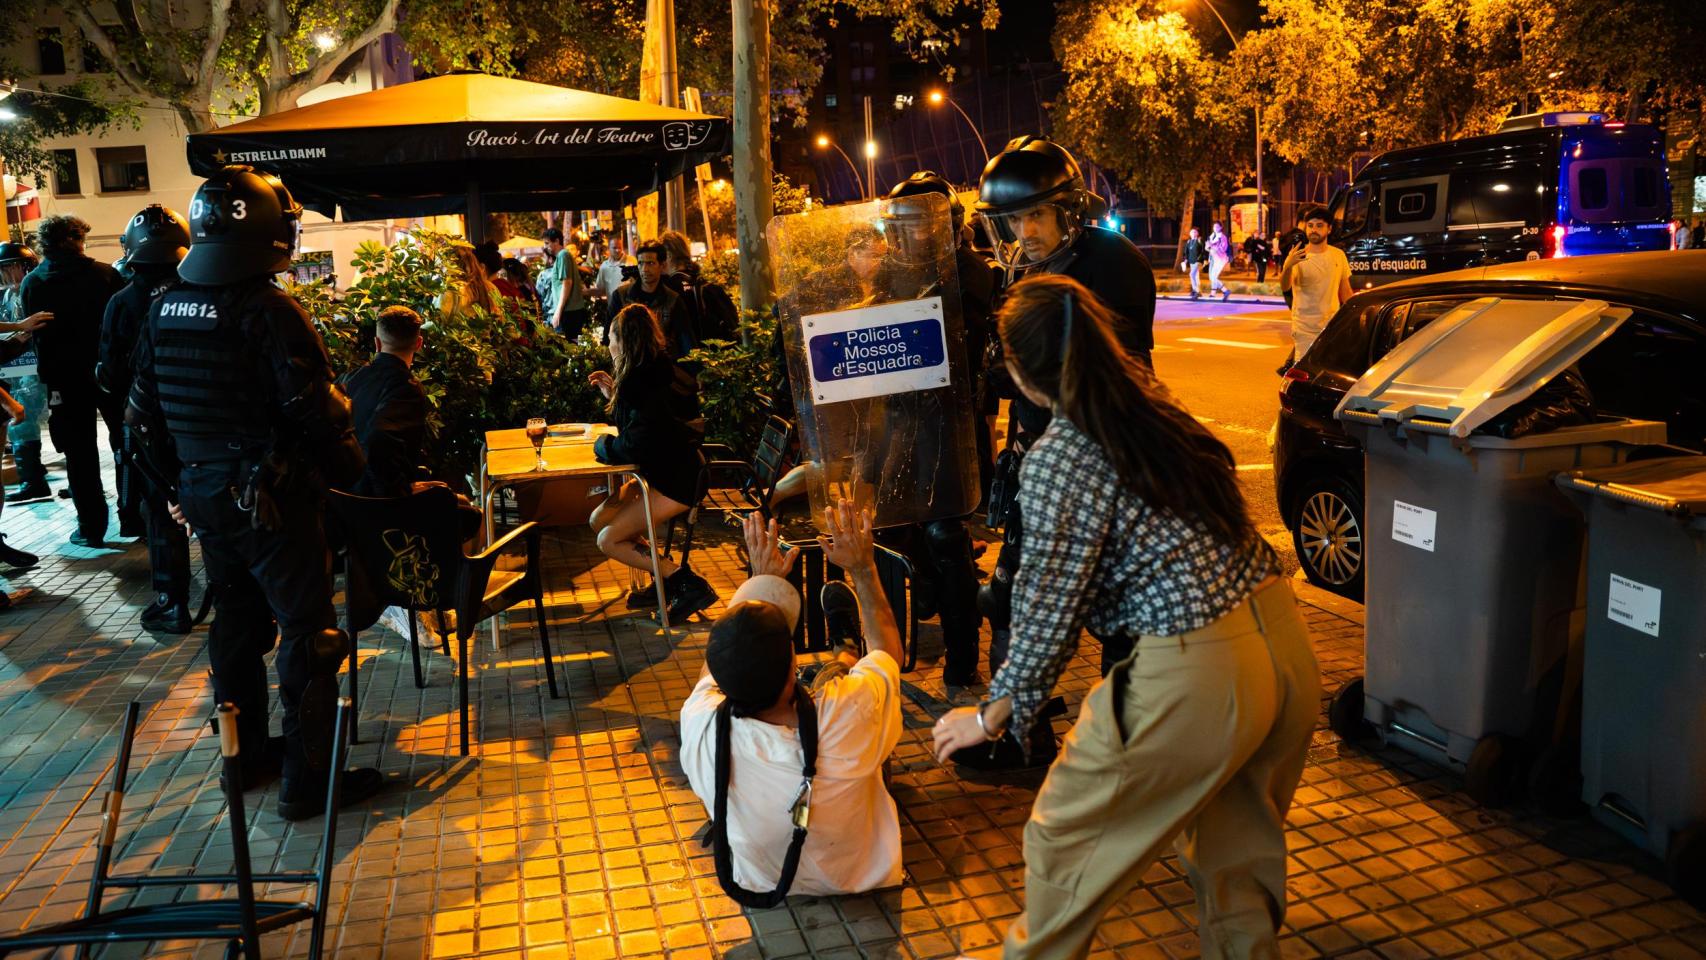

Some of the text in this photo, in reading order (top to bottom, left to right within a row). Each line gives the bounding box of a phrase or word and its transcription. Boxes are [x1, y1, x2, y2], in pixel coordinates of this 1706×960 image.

[466, 126, 655, 147] Racó Art del Teatre
[231, 147, 327, 162] ESTRELLA DAMM
[231, 199, 247, 220] 3
[133, 214, 145, 228] D
[1349, 256, 1427, 273] ssos d'esquadra
[160, 302, 218, 319] D1H612
[846, 326, 902, 346] Policia
[844, 341, 907, 361] Mossos
[832, 353, 922, 378] d'Esquadra
